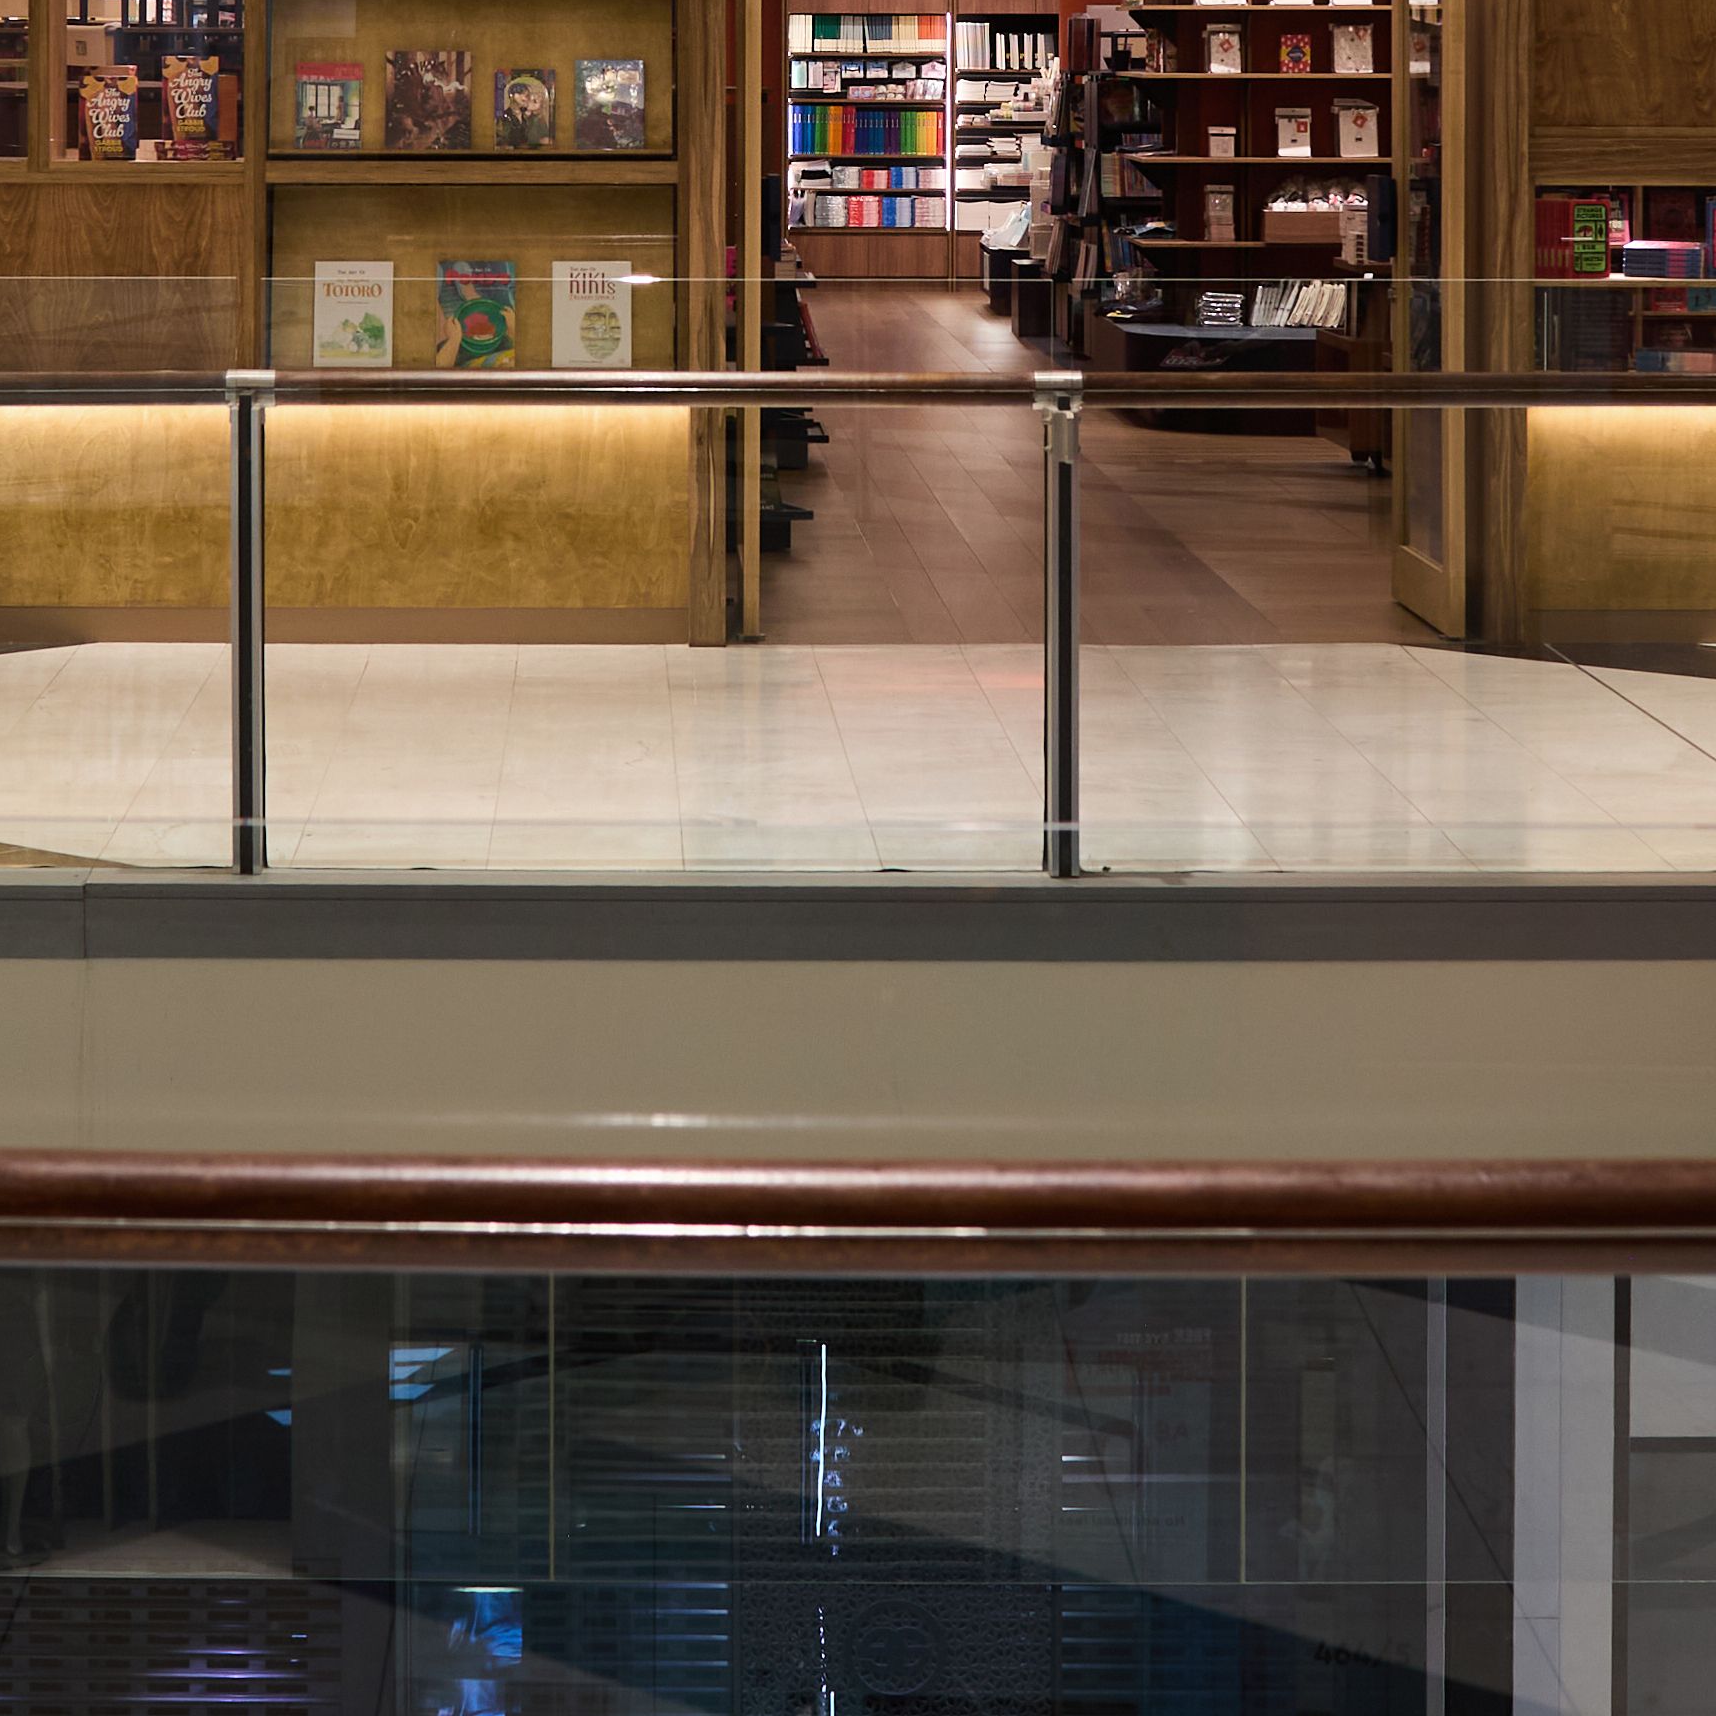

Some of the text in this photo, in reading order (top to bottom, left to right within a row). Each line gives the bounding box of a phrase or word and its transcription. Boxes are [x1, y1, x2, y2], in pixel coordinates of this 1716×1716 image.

[187, 68, 203, 77] The
[169, 73, 213, 91] Angry
[105, 88, 121, 97] The
[171, 89, 213, 104] Wives
[87, 93, 131, 111] Angry
[89, 109, 131, 124] Wives
[176, 104, 207, 119] Club
[93, 124, 124, 139] Club
[323, 282, 382, 298] TOTORO
